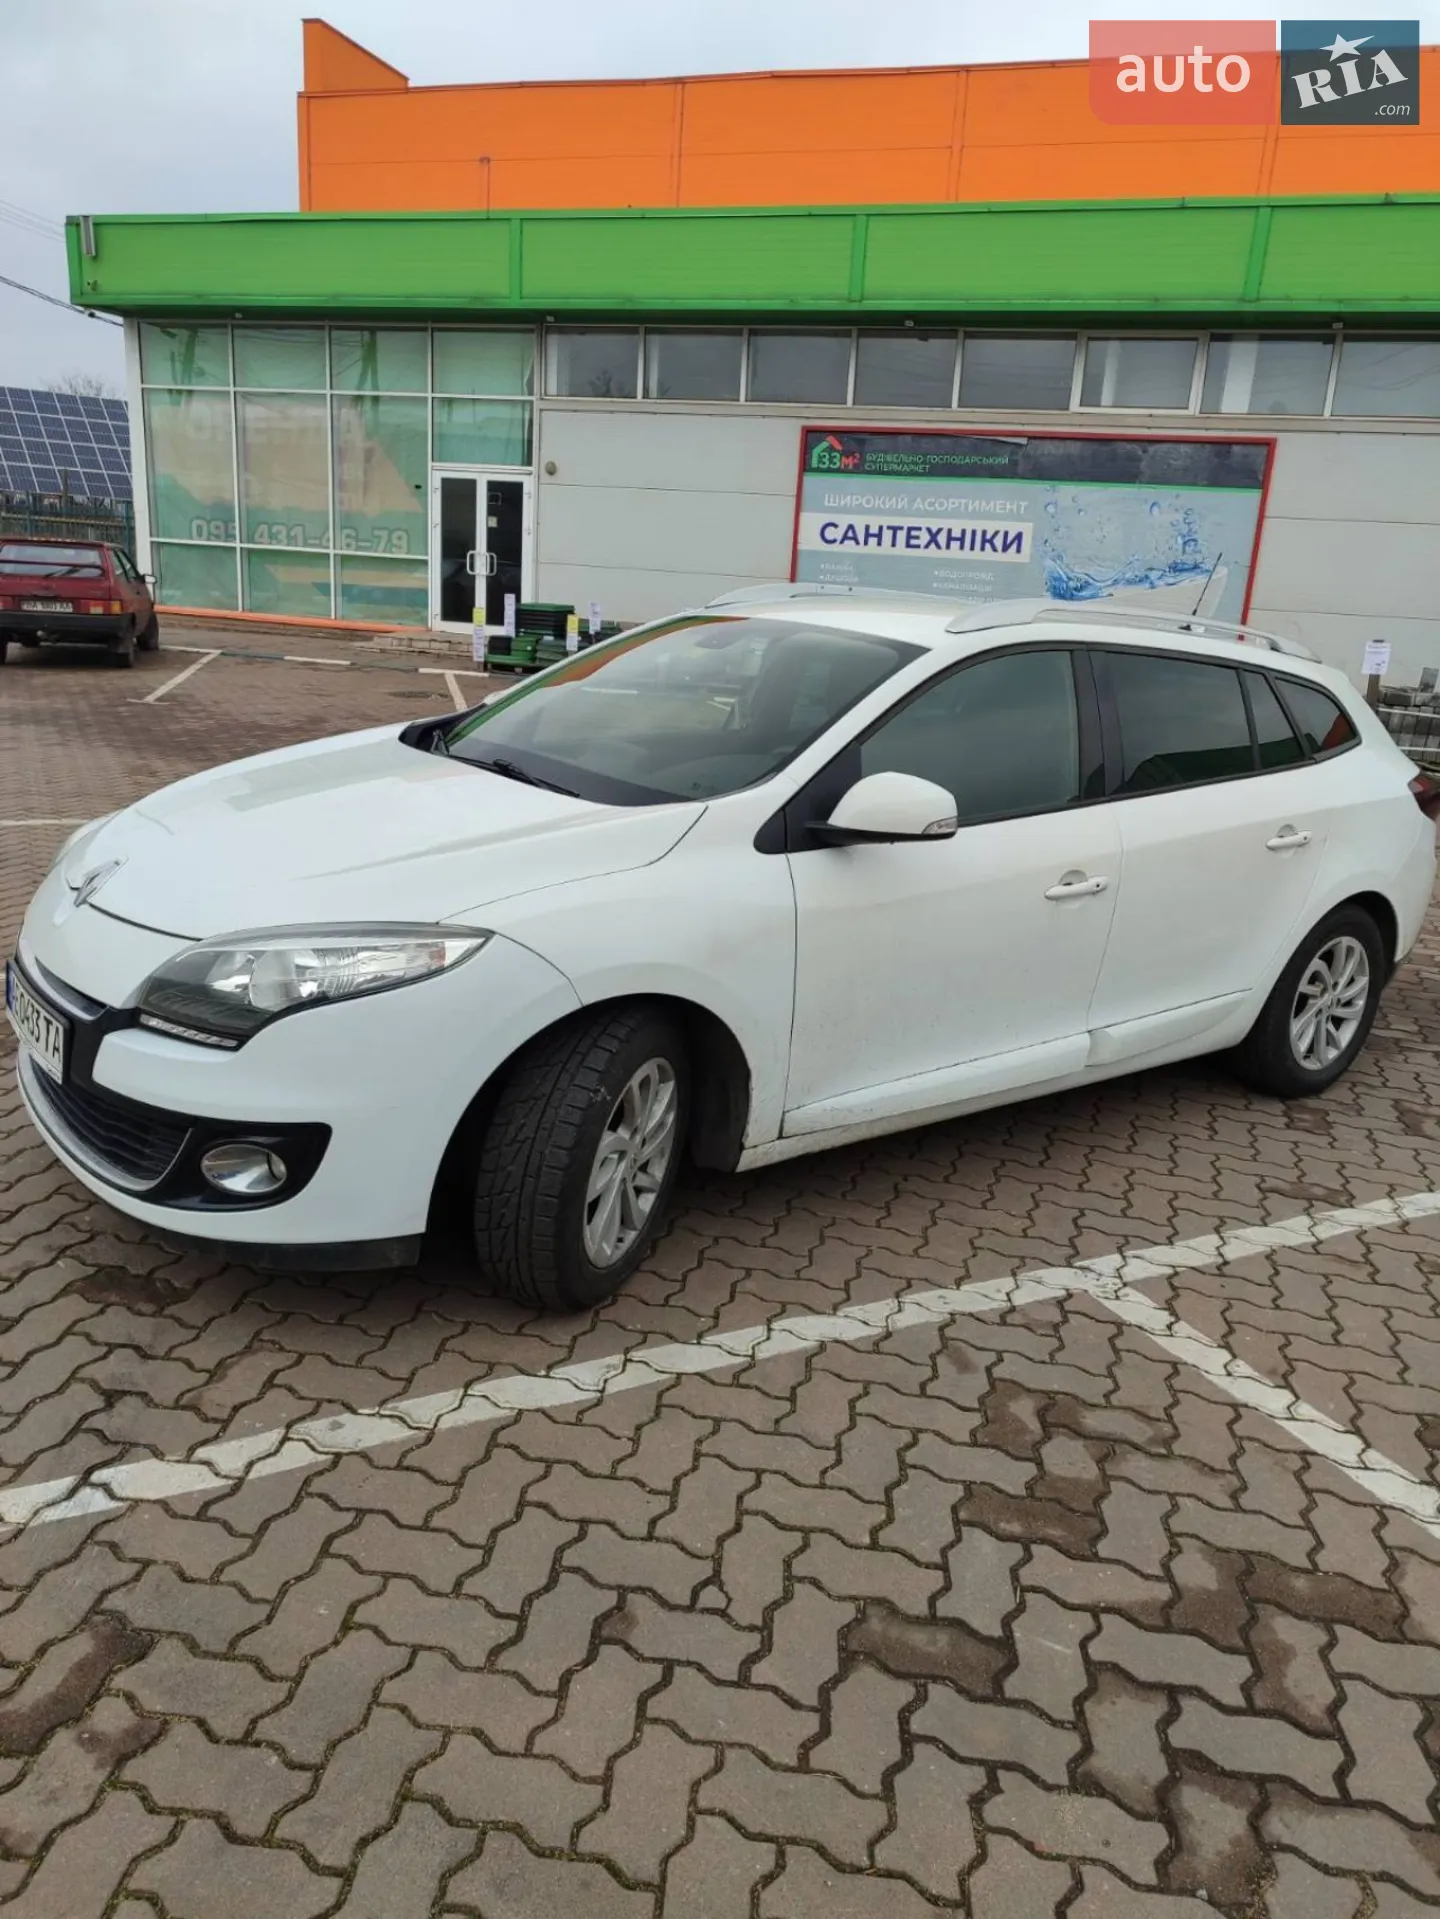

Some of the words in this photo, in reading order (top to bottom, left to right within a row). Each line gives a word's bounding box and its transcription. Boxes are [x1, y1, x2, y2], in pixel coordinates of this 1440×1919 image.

[824, 493, 908, 510] ШИРОКИЙ
[912, 498, 1028, 515] АСОРТИМЕНТ
[819, 521, 1024, 554] САНТЕХНІКИ
